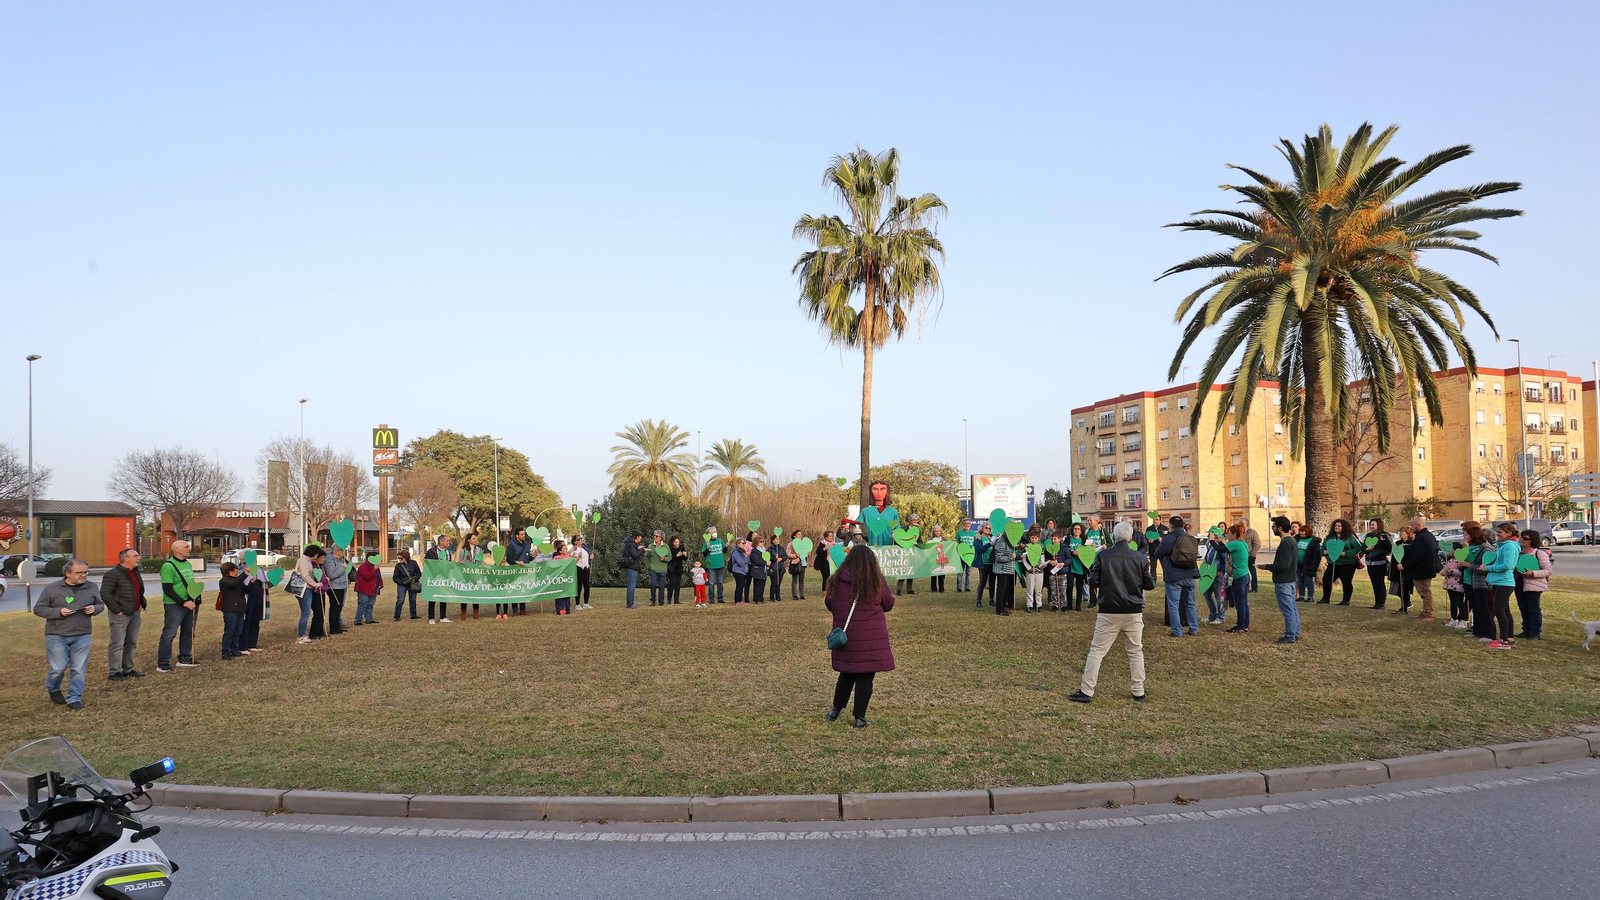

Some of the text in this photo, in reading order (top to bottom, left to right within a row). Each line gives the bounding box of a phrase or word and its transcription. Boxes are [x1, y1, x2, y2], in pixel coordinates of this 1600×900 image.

[873, 547, 915, 558] MAREA
[880, 556, 909, 568] Verde
[462, 566, 542, 576] MAREA VERDE JEREZ
[148, 880, 166, 888] LOCAL
